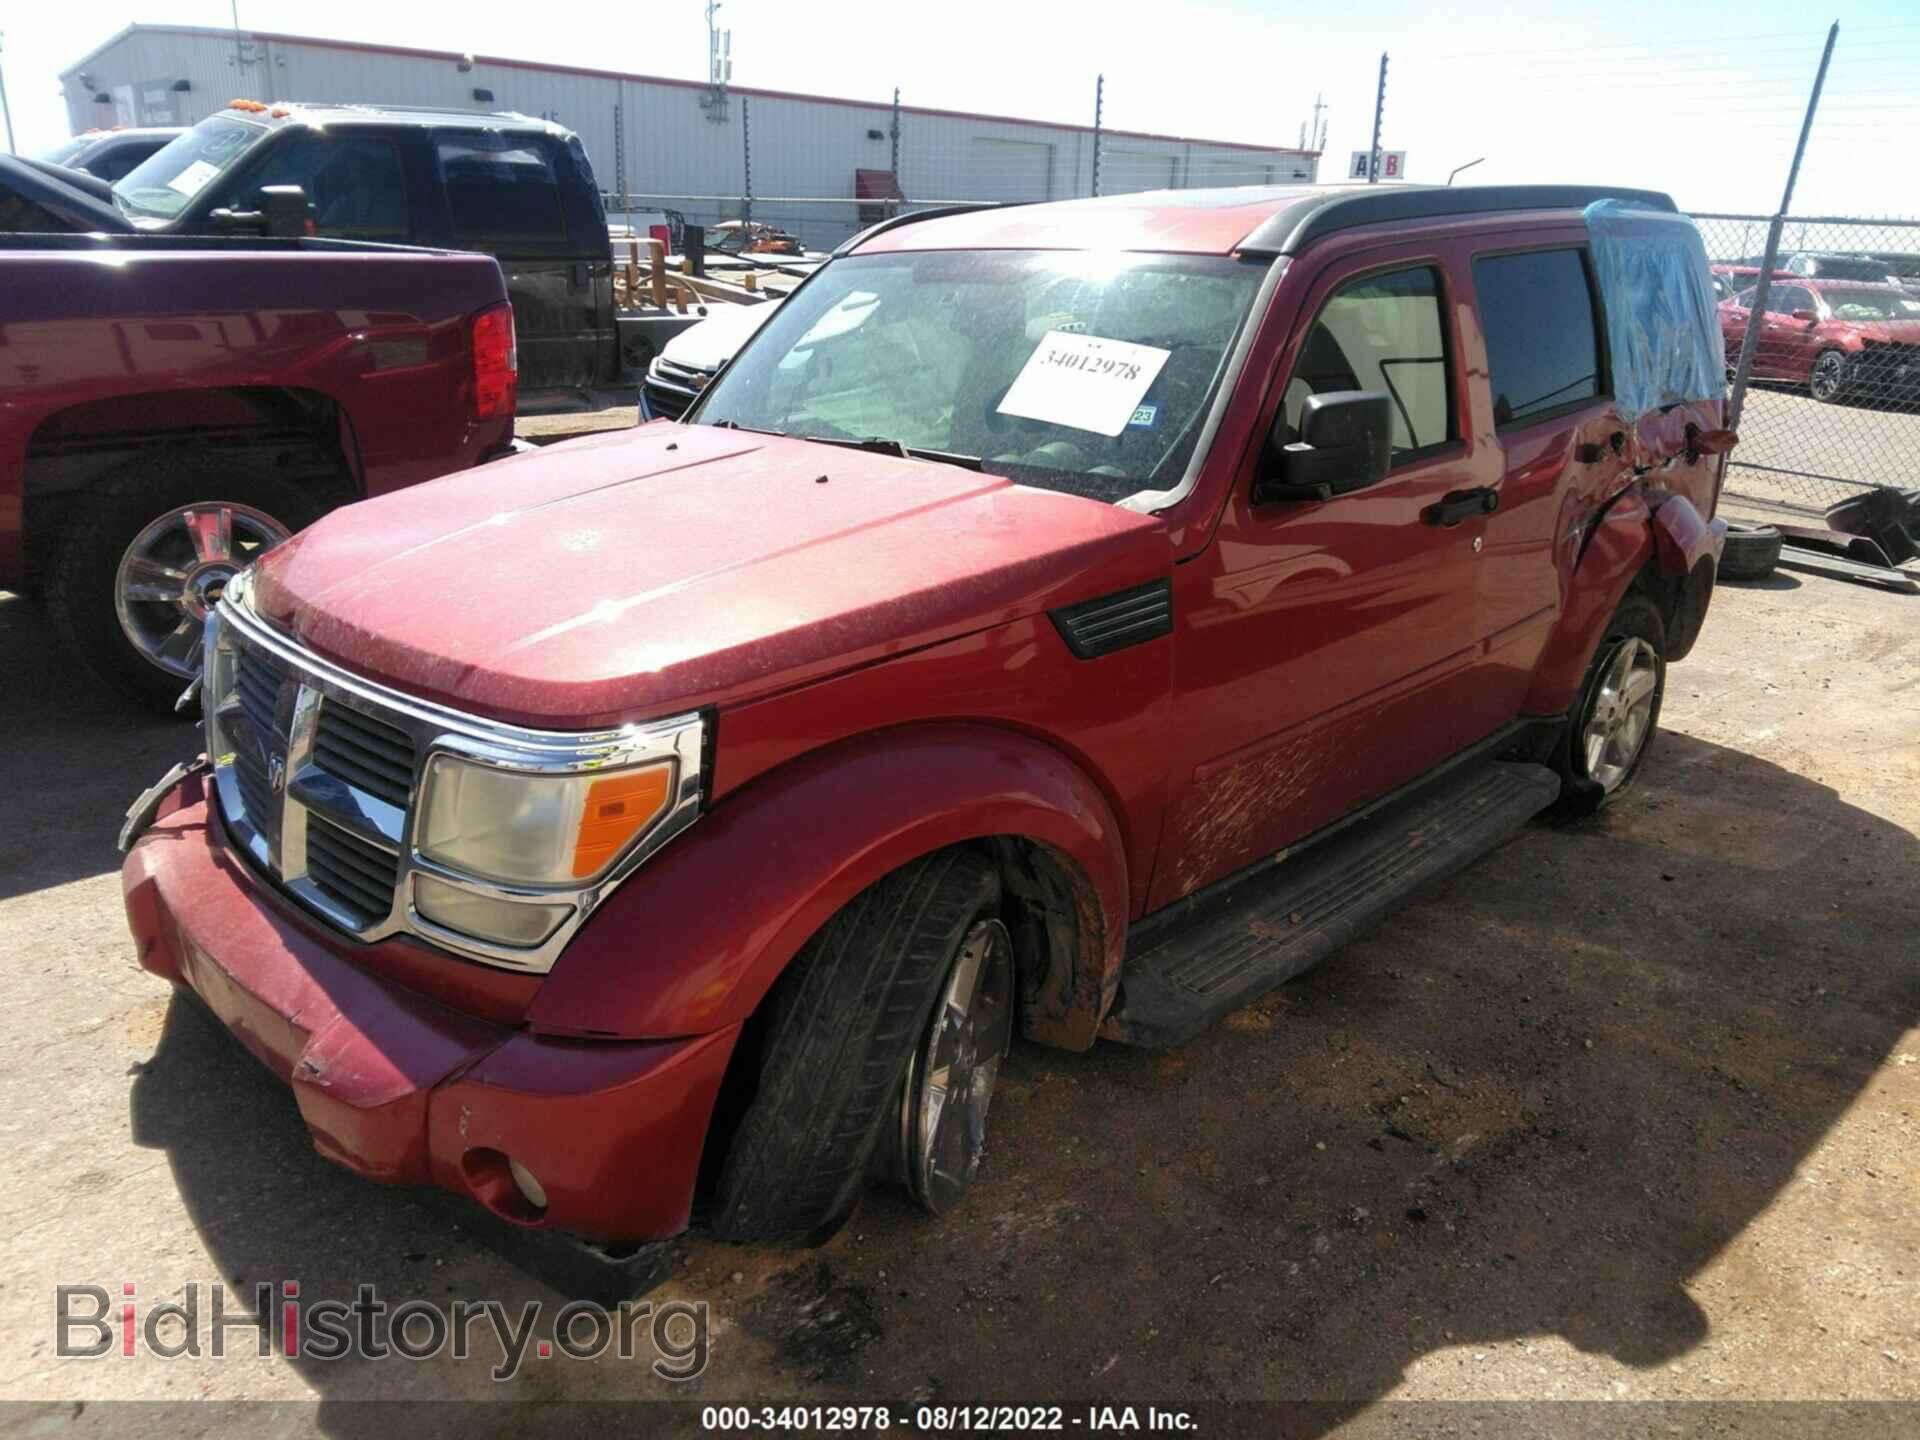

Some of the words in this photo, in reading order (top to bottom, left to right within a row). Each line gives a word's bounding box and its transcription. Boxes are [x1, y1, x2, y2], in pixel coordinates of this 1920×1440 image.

[1354, 154, 1367, 176] A
[1385, 154, 1399, 176] B
[1041, 350, 1142, 381] 34012978
[1134, 410, 1152, 421] 23
